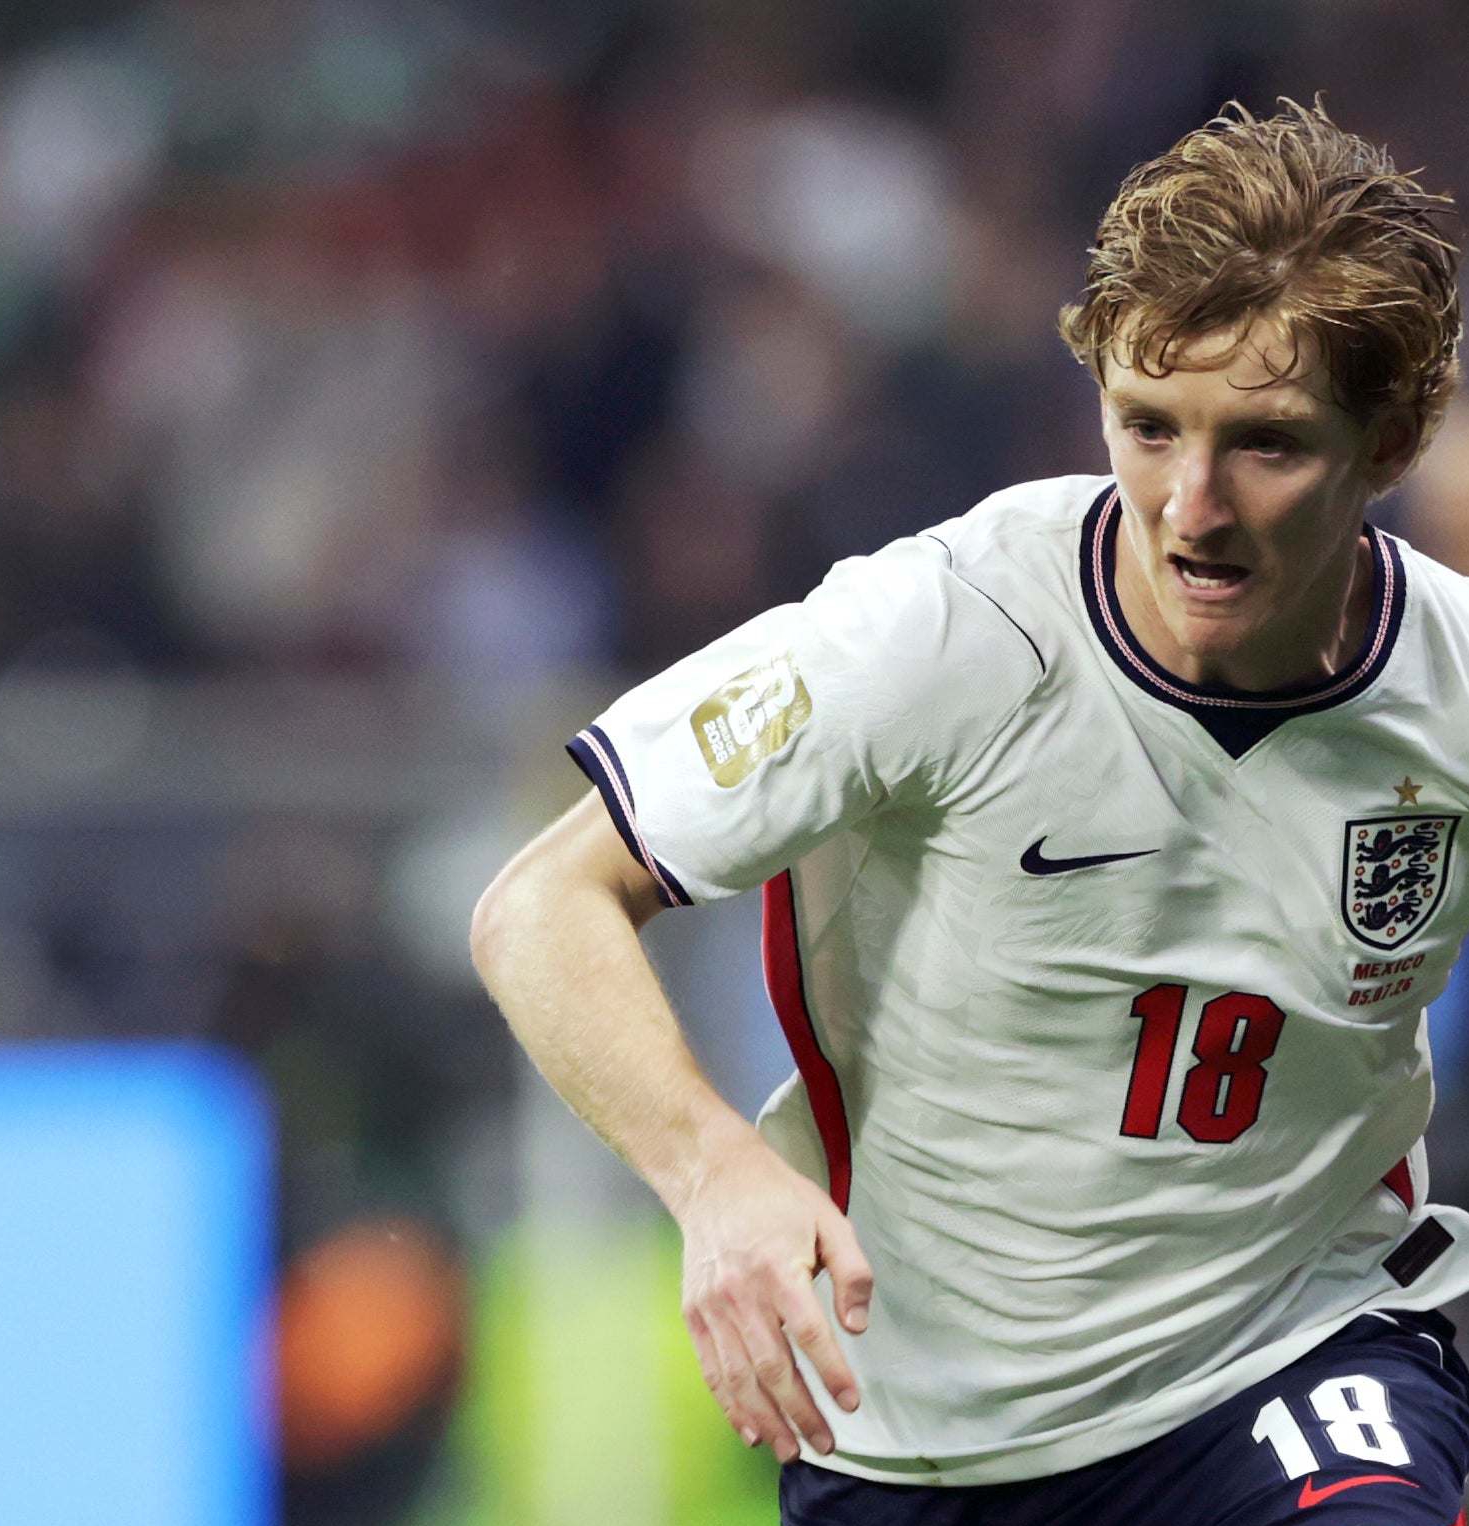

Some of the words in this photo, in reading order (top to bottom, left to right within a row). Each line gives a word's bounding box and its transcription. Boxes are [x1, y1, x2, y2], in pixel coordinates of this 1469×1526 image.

[702, 719, 729, 765] 2026
[1353, 954, 1425, 980] MEXICO
[1348, 977, 1414, 1006] 05.07.26
[1119, 983, 1287, 1144] 18
[1251, 1374, 1414, 1482] 18
